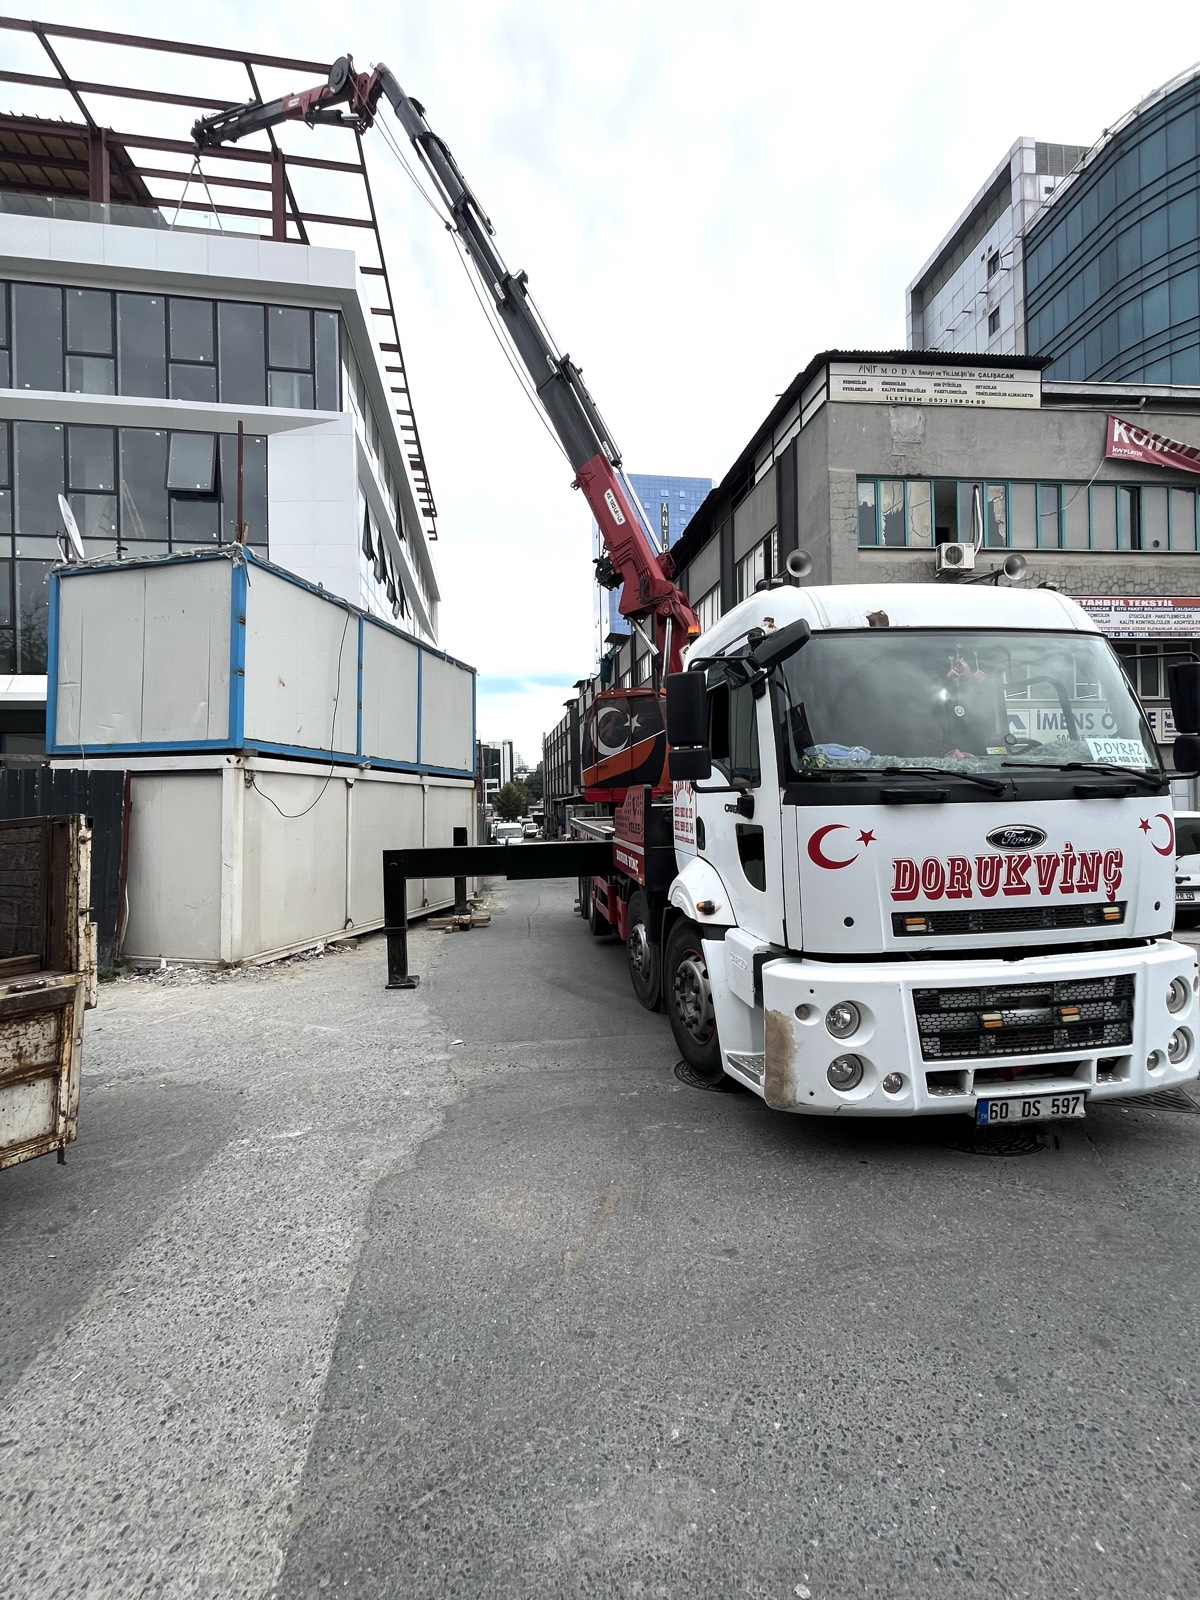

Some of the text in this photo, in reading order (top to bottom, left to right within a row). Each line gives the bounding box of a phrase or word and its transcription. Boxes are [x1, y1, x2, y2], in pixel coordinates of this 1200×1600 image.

[978, 372, 1014, 380] ÇALIŞACAK
[886, 394, 922, 402] İLETİŞİM
[1073, 598, 1174, 607] STANBUL TEKSTİL
[1093, 741, 1143, 756] POYRAZ
[990, 1102, 1009, 1120] 60
[1022, 1100, 1041, 1118] DS
[1051, 1096, 1080, 1115] 597
